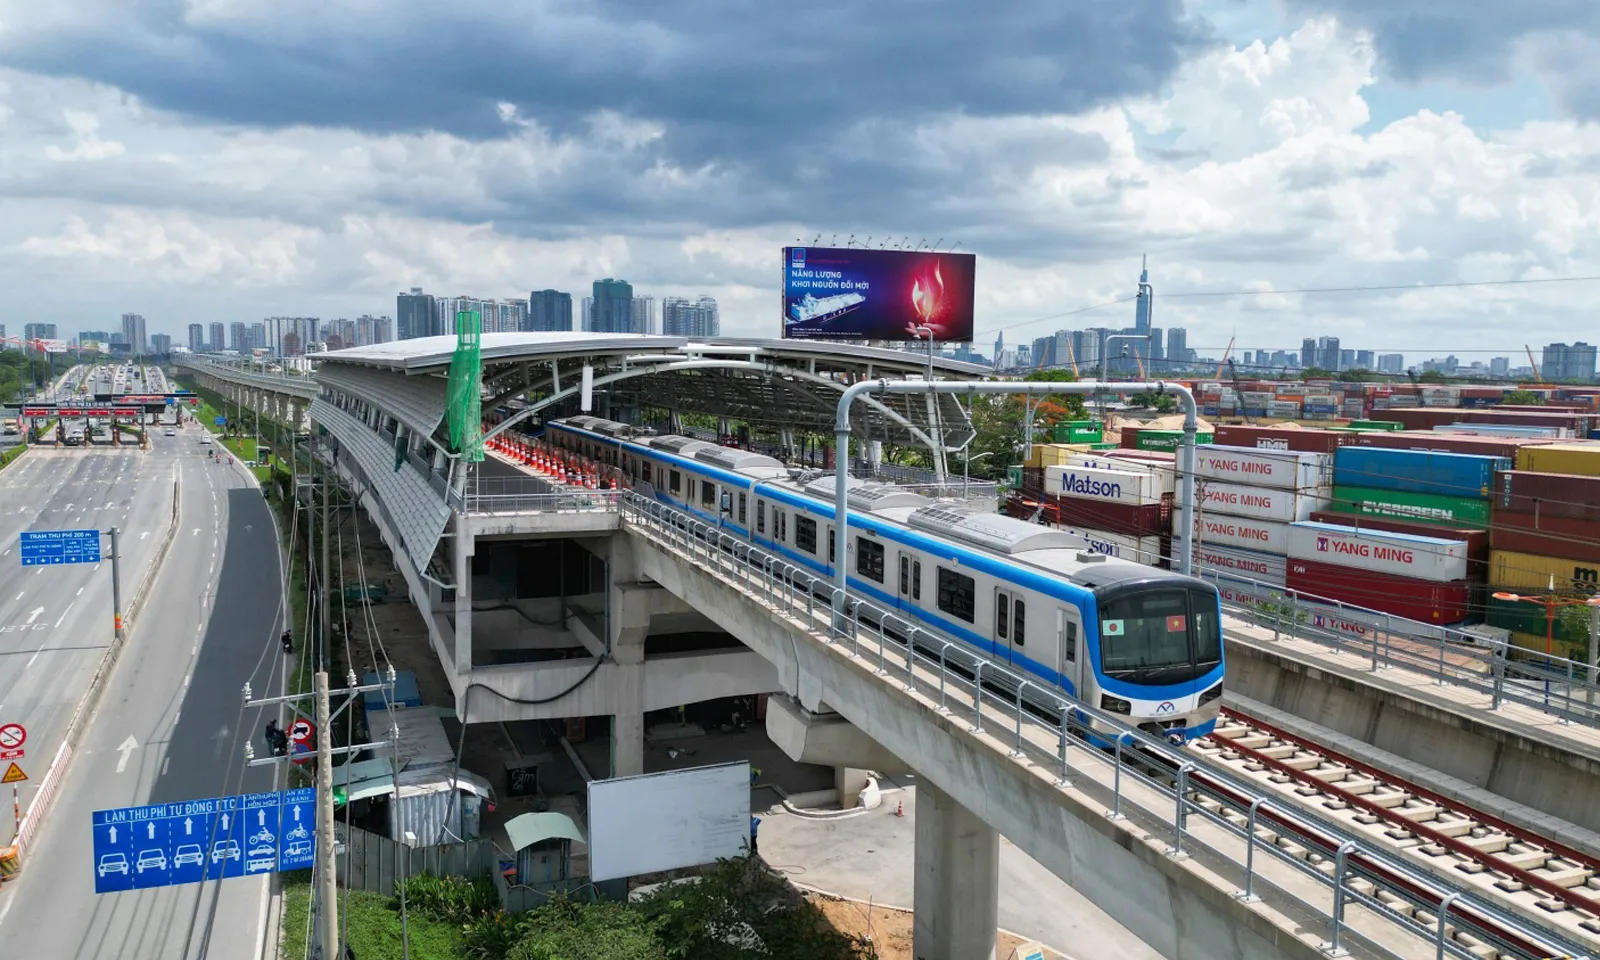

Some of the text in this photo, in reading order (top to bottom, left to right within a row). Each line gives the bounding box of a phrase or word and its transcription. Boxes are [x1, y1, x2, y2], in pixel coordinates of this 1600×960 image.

[1209, 459, 1272, 475] YANG MING
[1062, 473, 1120, 498] Matson
[1208, 491, 1271, 508] YANG MING
[1363, 500, 1453, 520] EVERGREEN
[1206, 522, 1269, 541] YANG MING
[1332, 541, 1413, 564] YANG MING
[1205, 554, 1268, 574] YANG MING
[105, 809, 126, 823] LÀN
[128, 808, 148, 820] THU
[150, 803, 166, 818] PHÍ
